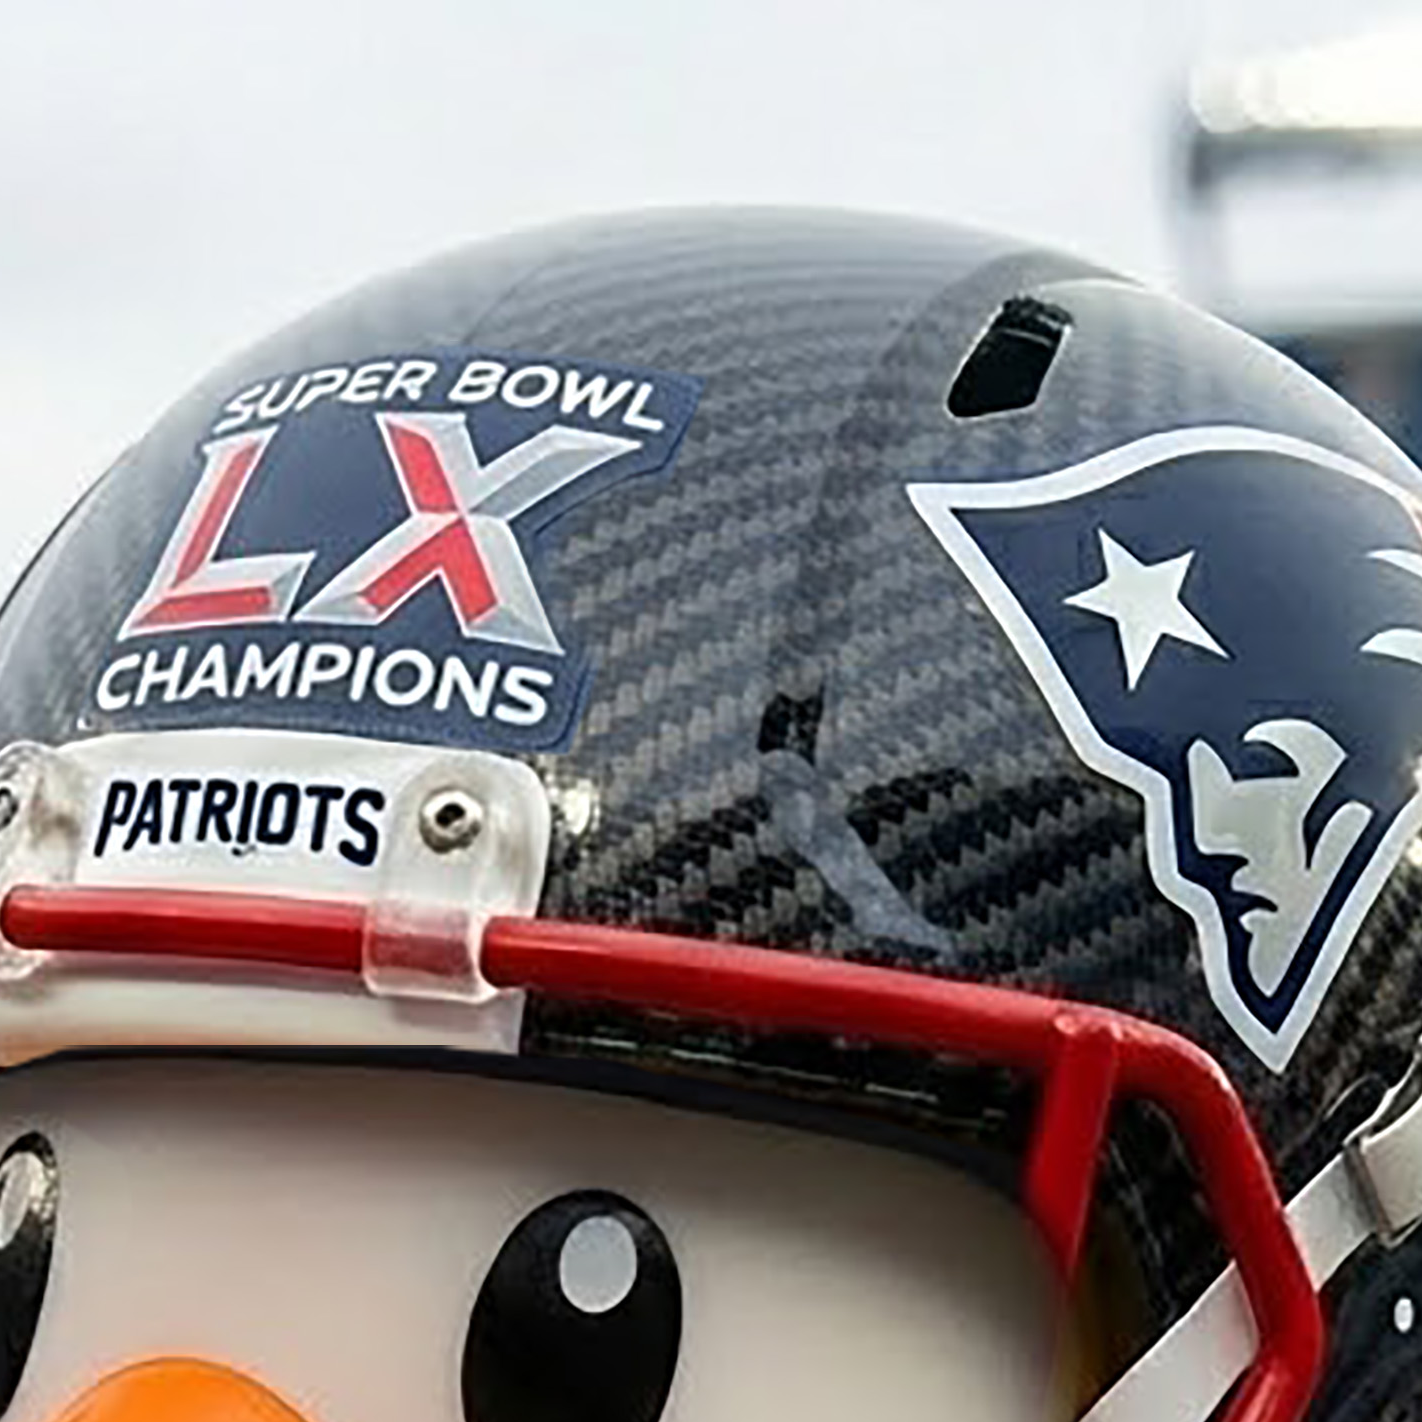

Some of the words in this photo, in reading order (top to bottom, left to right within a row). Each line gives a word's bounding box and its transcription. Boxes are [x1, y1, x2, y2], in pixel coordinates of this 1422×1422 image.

[215, 360, 438, 435] SUPER
[448, 360, 665, 432] BOWL
[116, 411, 642, 657] LX
[95, 641, 554, 728] CHAMPIONS
[93, 777, 386, 867] PATRIOTS
